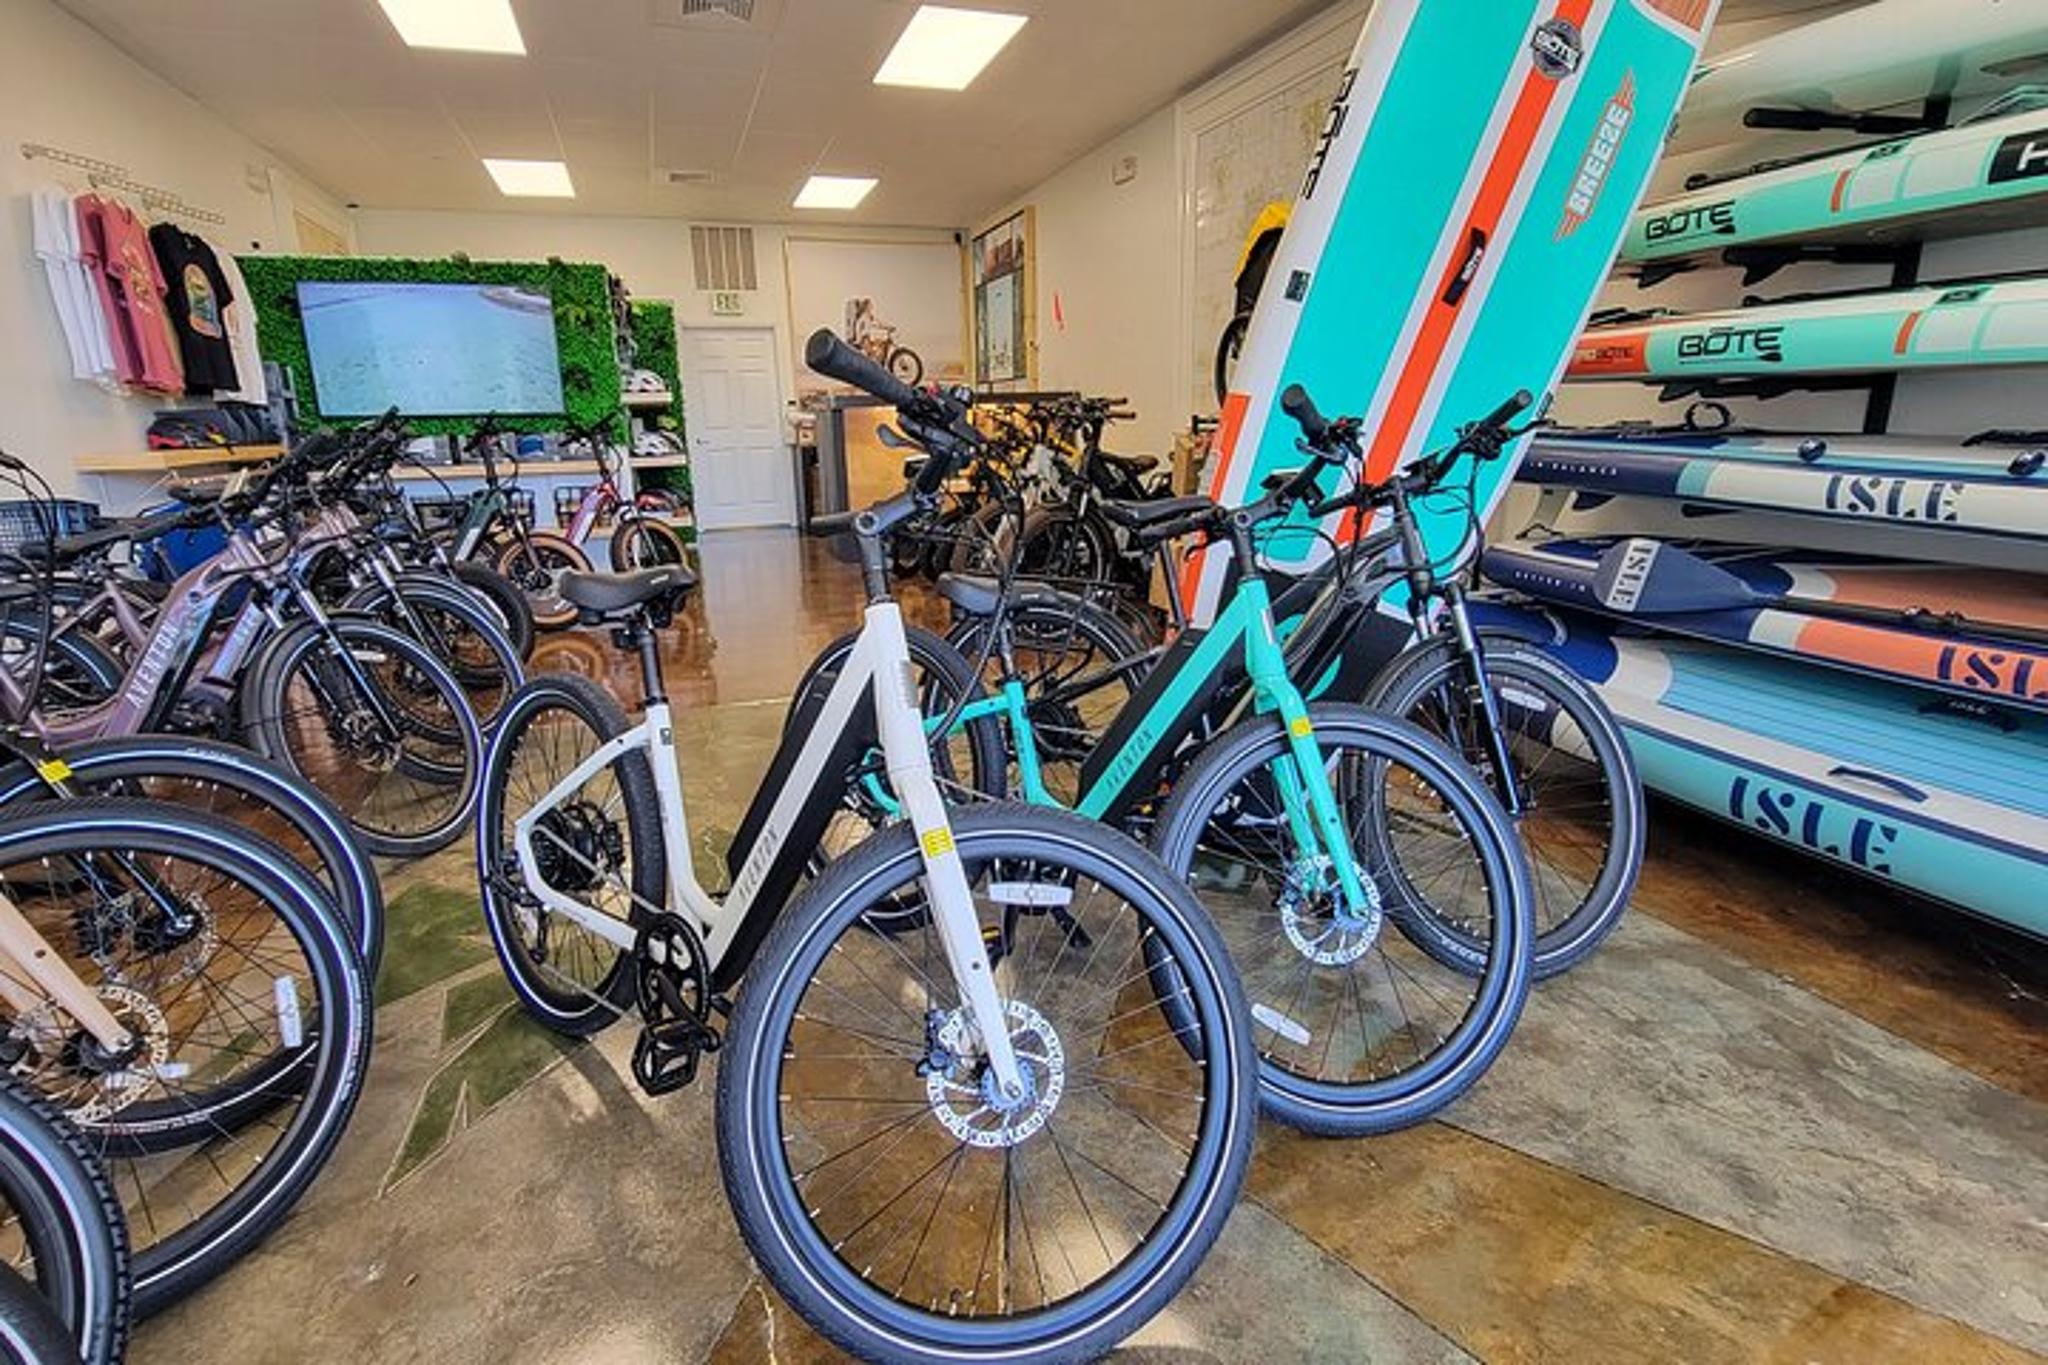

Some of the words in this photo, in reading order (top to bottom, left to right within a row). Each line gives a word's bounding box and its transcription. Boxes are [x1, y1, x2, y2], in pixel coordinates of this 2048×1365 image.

[1569, 102, 1631, 215] BREEZE
[1826, 474, 1964, 522] ISLE
[1612, 546, 1653, 605] ISLE
[125, 623, 180, 708] AVENTON
[1729, 775, 1898, 876] ISLE
